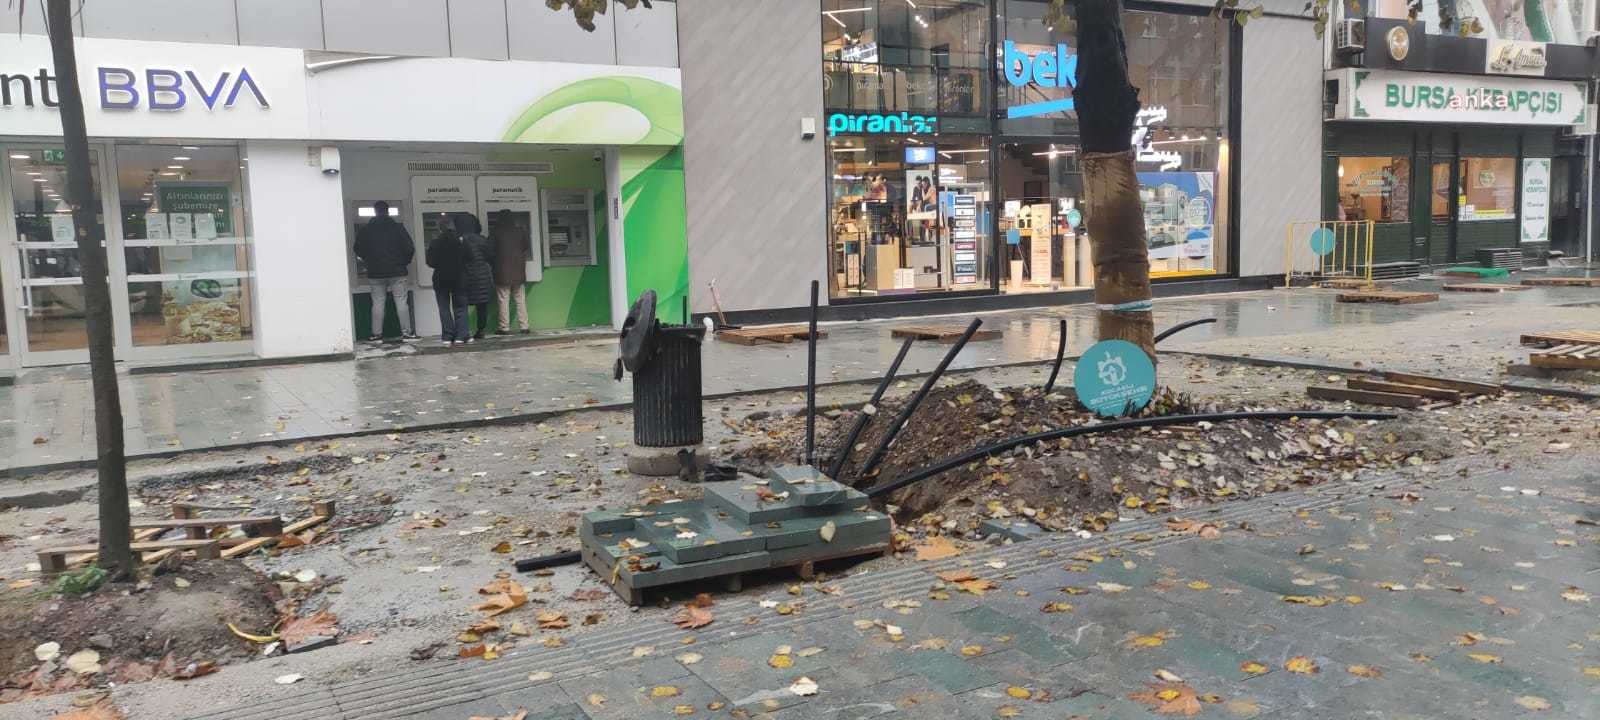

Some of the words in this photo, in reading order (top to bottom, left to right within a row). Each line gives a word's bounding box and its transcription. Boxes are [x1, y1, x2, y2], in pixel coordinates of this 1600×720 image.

[98, 66, 270, 112] BBVA
[1385, 84, 1456, 110] BURSA
[1466, 87, 1563, 118] KEBAPÇISI
[828, 112, 936, 136] piranlar
